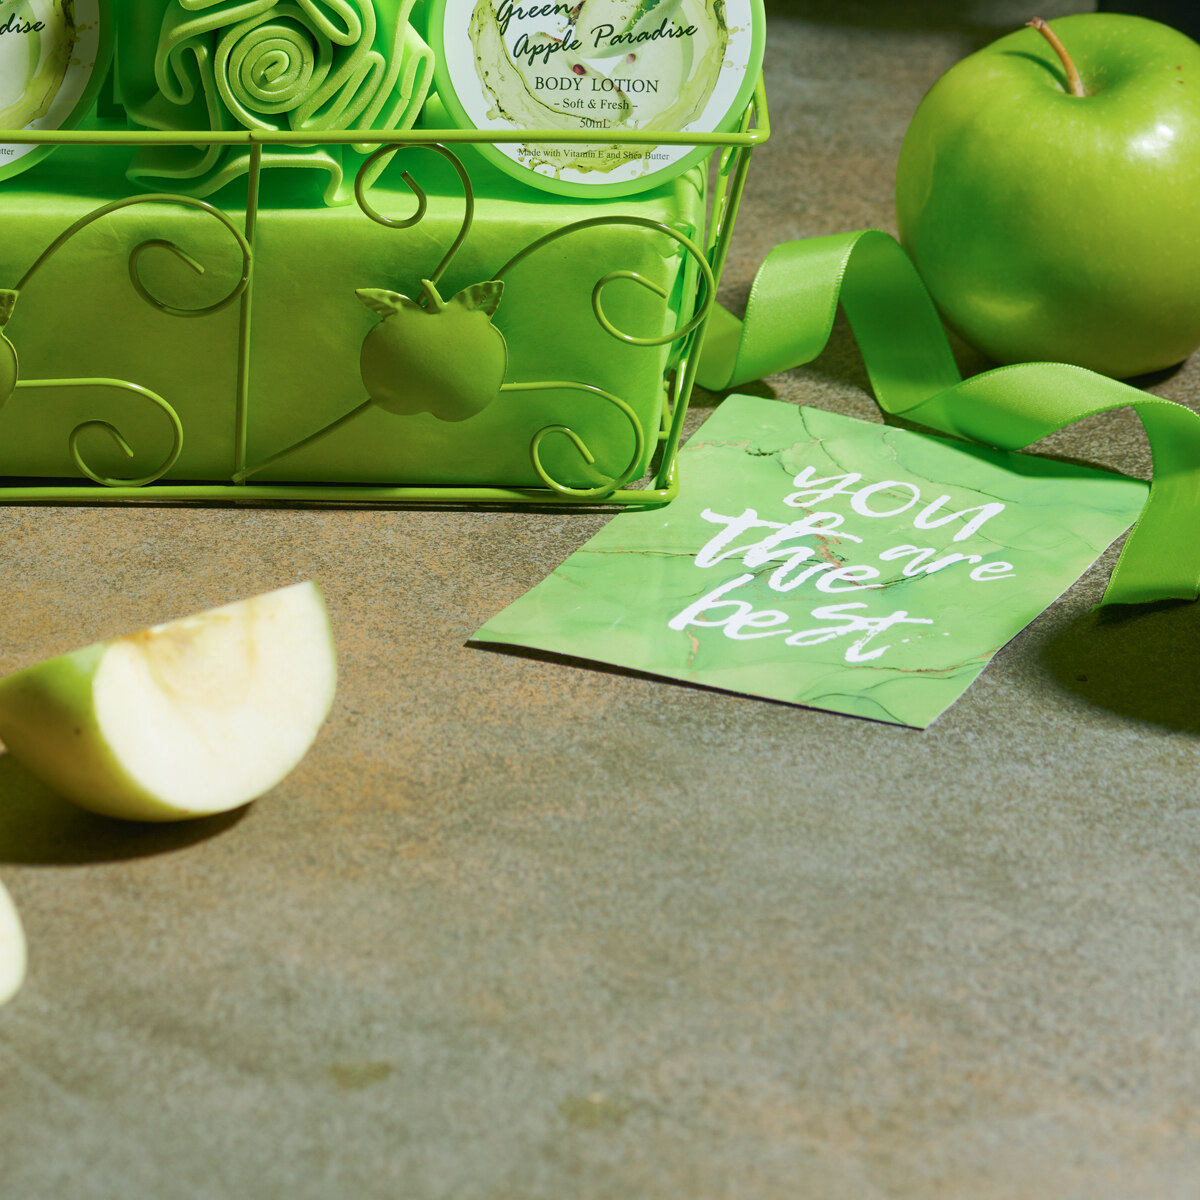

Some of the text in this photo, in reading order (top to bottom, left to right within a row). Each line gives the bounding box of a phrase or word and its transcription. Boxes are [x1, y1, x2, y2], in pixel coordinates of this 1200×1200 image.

[513, 18, 698, 66] Apple Paradise
[535, 76, 659, 93] BODY LOTION
[562, 98, 584, 109] Soft
[587, 99, 596, 109] &
[600, 99, 629, 110] Fresh
[579, 118, 611, 129] 50mL
[518, 148, 541, 157] Made
[543, 149, 561, 157] with
[563, 149, 596, 159] Vitamin
[598, 150, 604, 159] E
[606, 151, 621, 159] and
[645, 151, 670, 161] Butter
[782, 466, 1006, 542] you
[694, 508, 885, 593] the
[878, 544, 1017, 582] are
[668, 573, 934, 663] best
